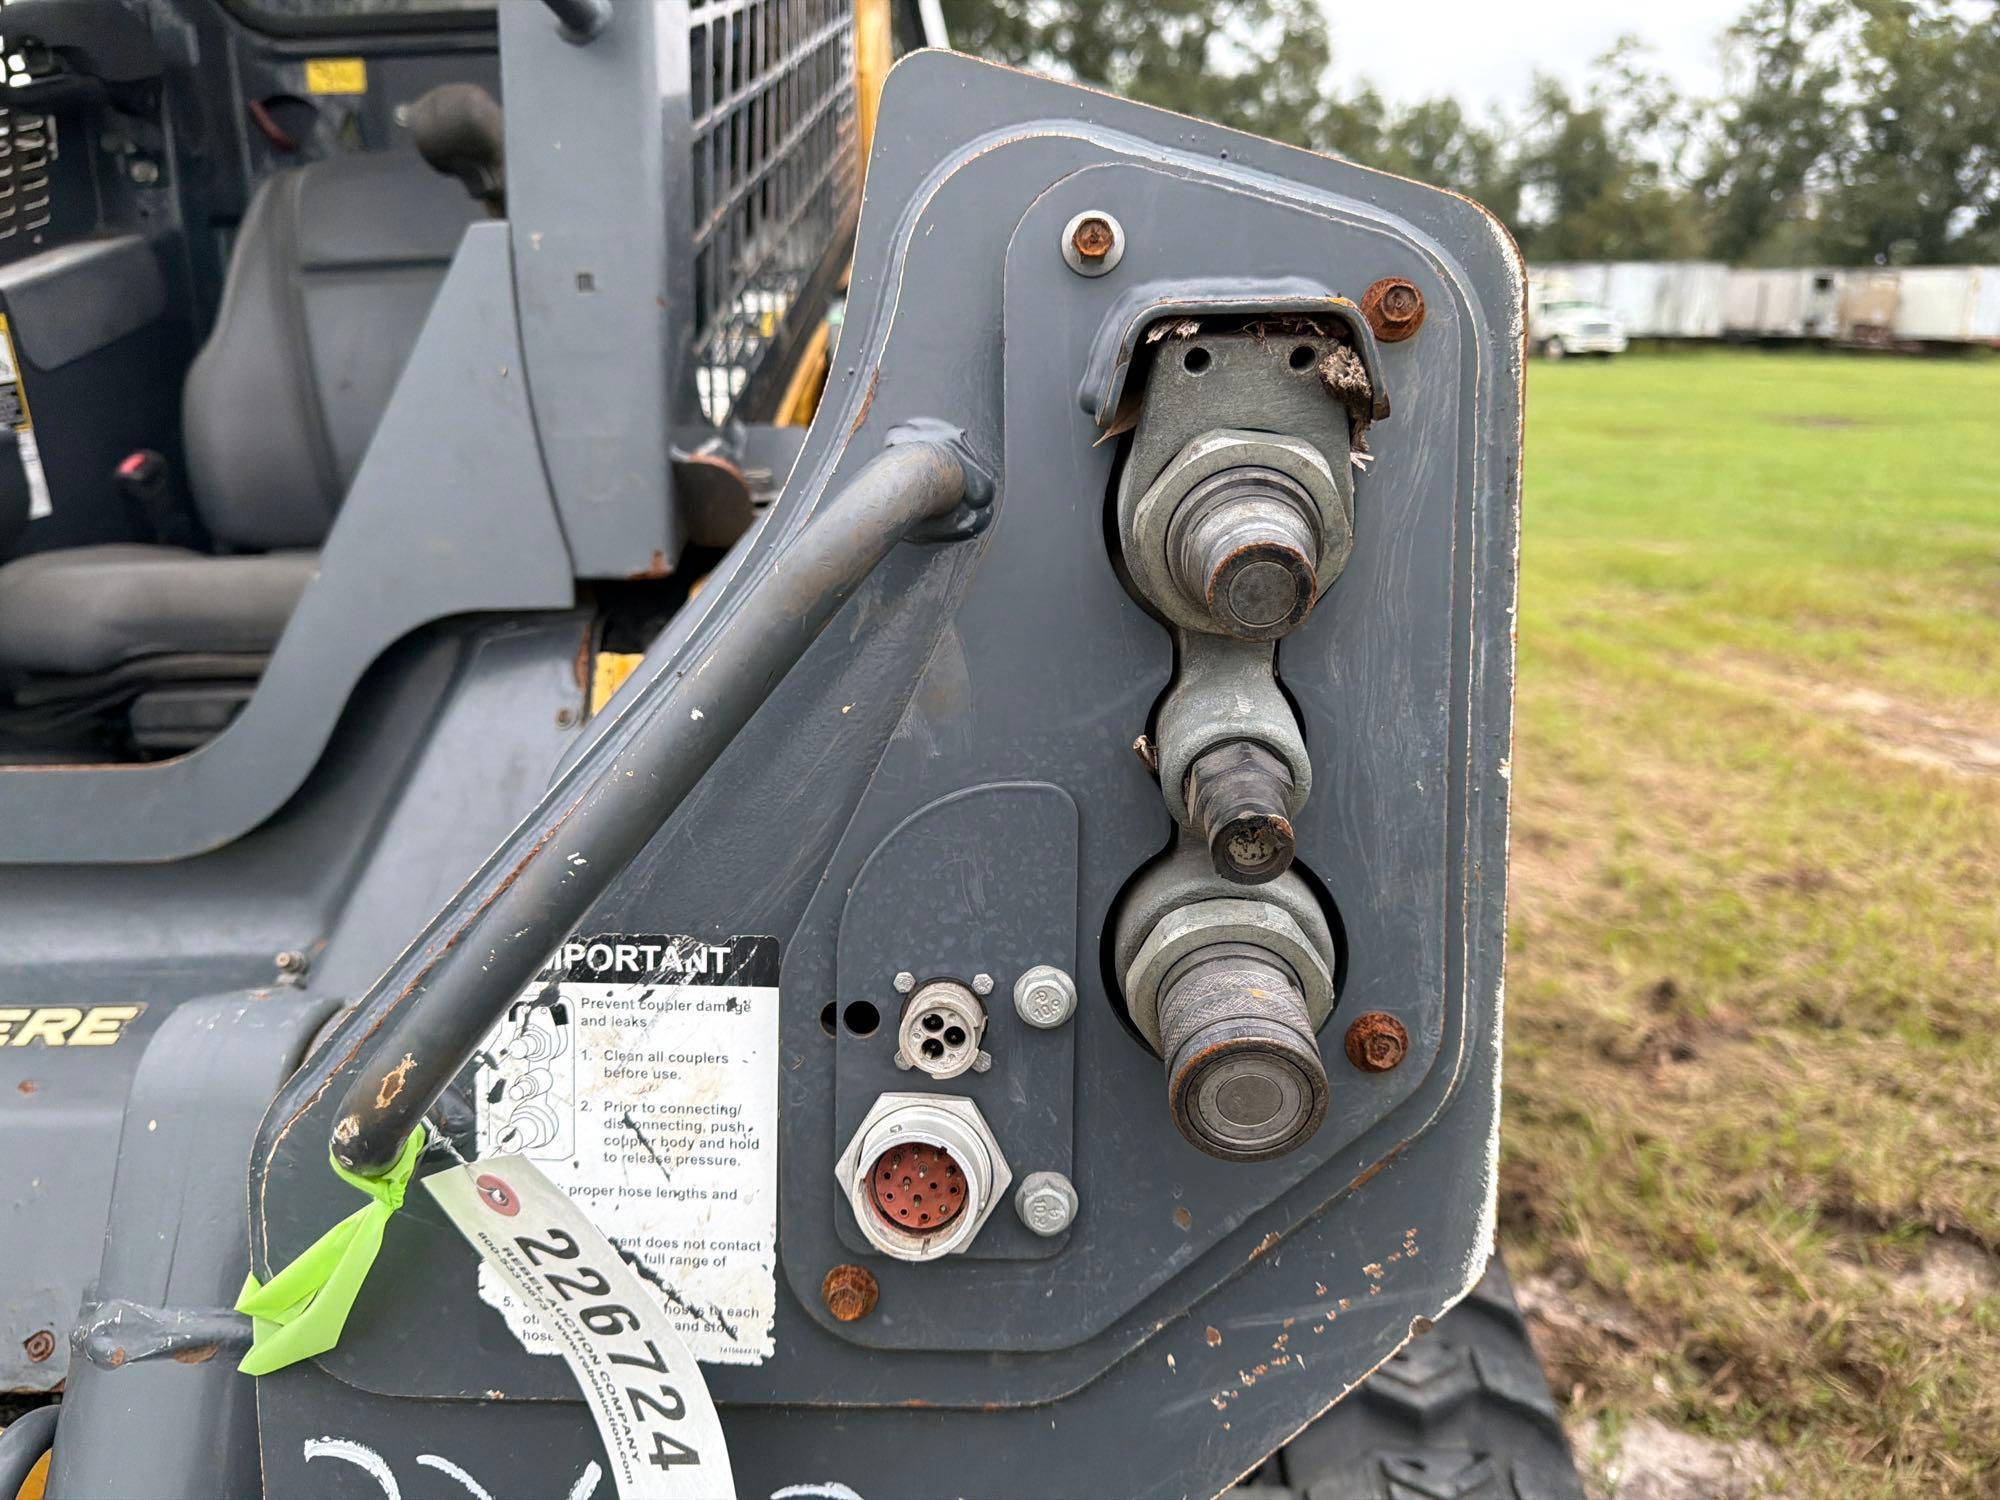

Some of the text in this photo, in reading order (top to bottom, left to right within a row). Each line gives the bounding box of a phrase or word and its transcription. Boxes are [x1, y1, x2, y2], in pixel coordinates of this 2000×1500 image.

[581, 997, 751, 1015] Prevent coupler damge
[581, 1016, 647, 1027] and leaks
[582, 1050, 729, 1066] 1. Clean all couplers
[604, 1067, 681, 1081] before use.
[580, 1101, 742, 1118] 2. Prior to connecting/
[604, 1118, 706, 1134] disonnecting,
[661, 1136, 694, 1151] body
[699, 1139, 725, 1149] and
[729, 1139, 760, 1150] hold
[604, 1152, 617, 1162] to
[676, 1156, 741, 1168] pressure.
[569, 1185, 738, 1201] proper hose lengths and
[645, 1236, 678, 1248] does
[684, 1239, 706, 1249] not
[710, 1240, 761, 1251] contact
[644, 1252, 727, 1268] full range of
[504, 1295, 514, 1307] 5.
[727, 1306, 759, 1318] each
[674, 1322, 738, 1334] and stoe
[502, 1247, 641, 1463] REBEL AUCTION COMPANY
[514, 1228, 700, 1471] 226724
[554, 1321, 633, 1485] www.rebelauction.com
